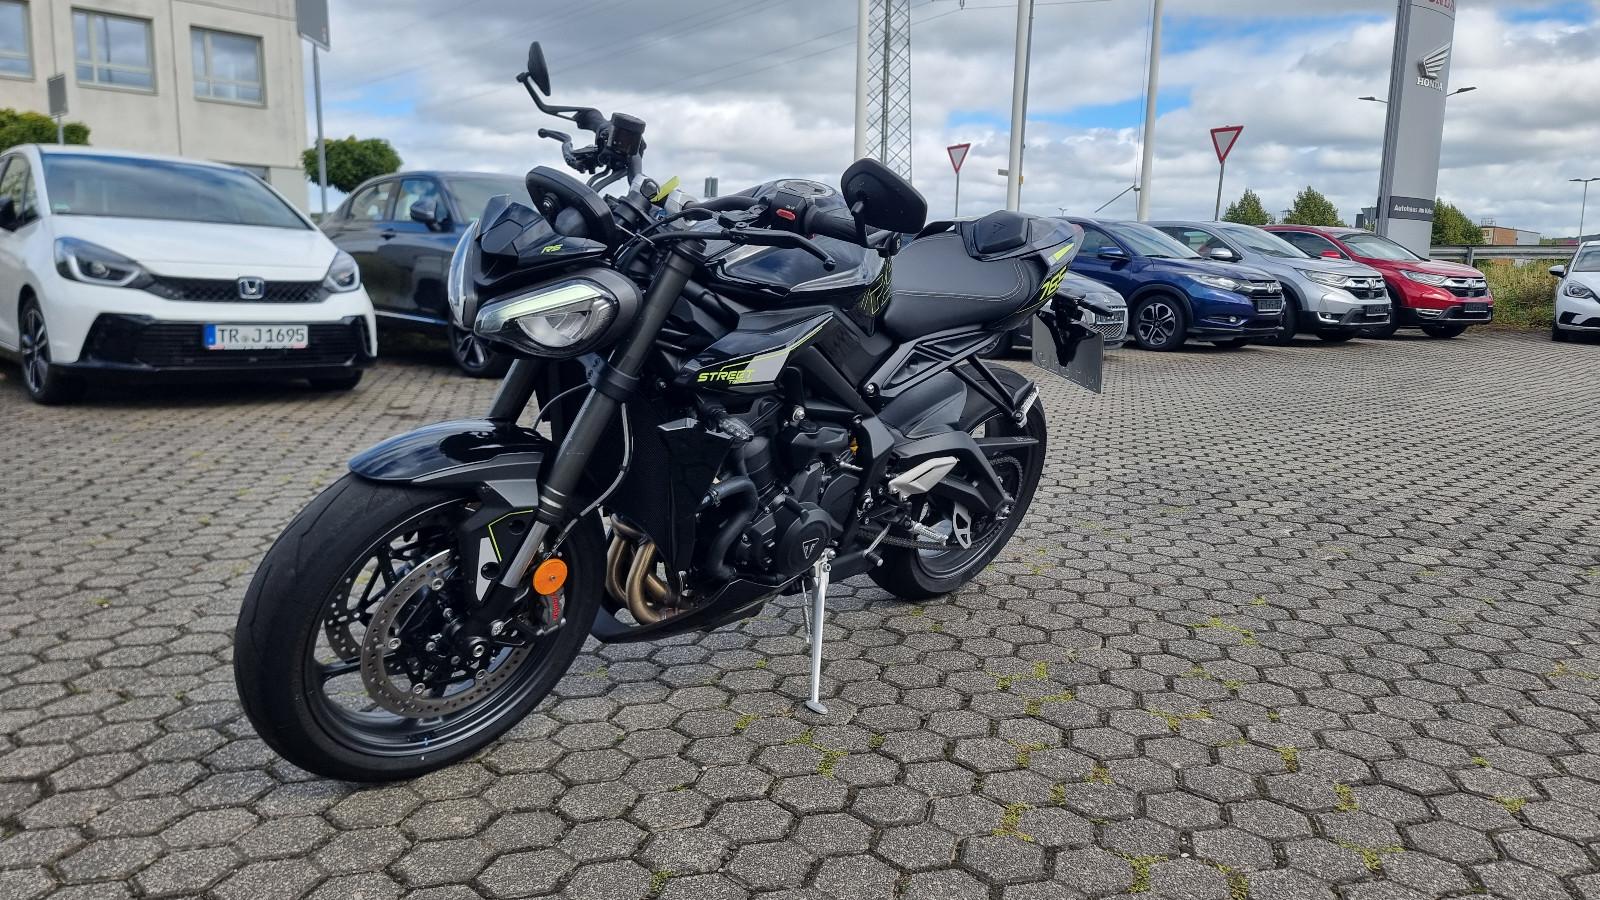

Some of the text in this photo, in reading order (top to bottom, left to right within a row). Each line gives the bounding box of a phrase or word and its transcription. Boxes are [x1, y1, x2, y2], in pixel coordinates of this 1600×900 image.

[1416, 77, 1443, 91] HONDA
[541, 244, 563, 254] RS
[218, 328, 240, 343] TR
[697, 369, 754, 382] STREET
